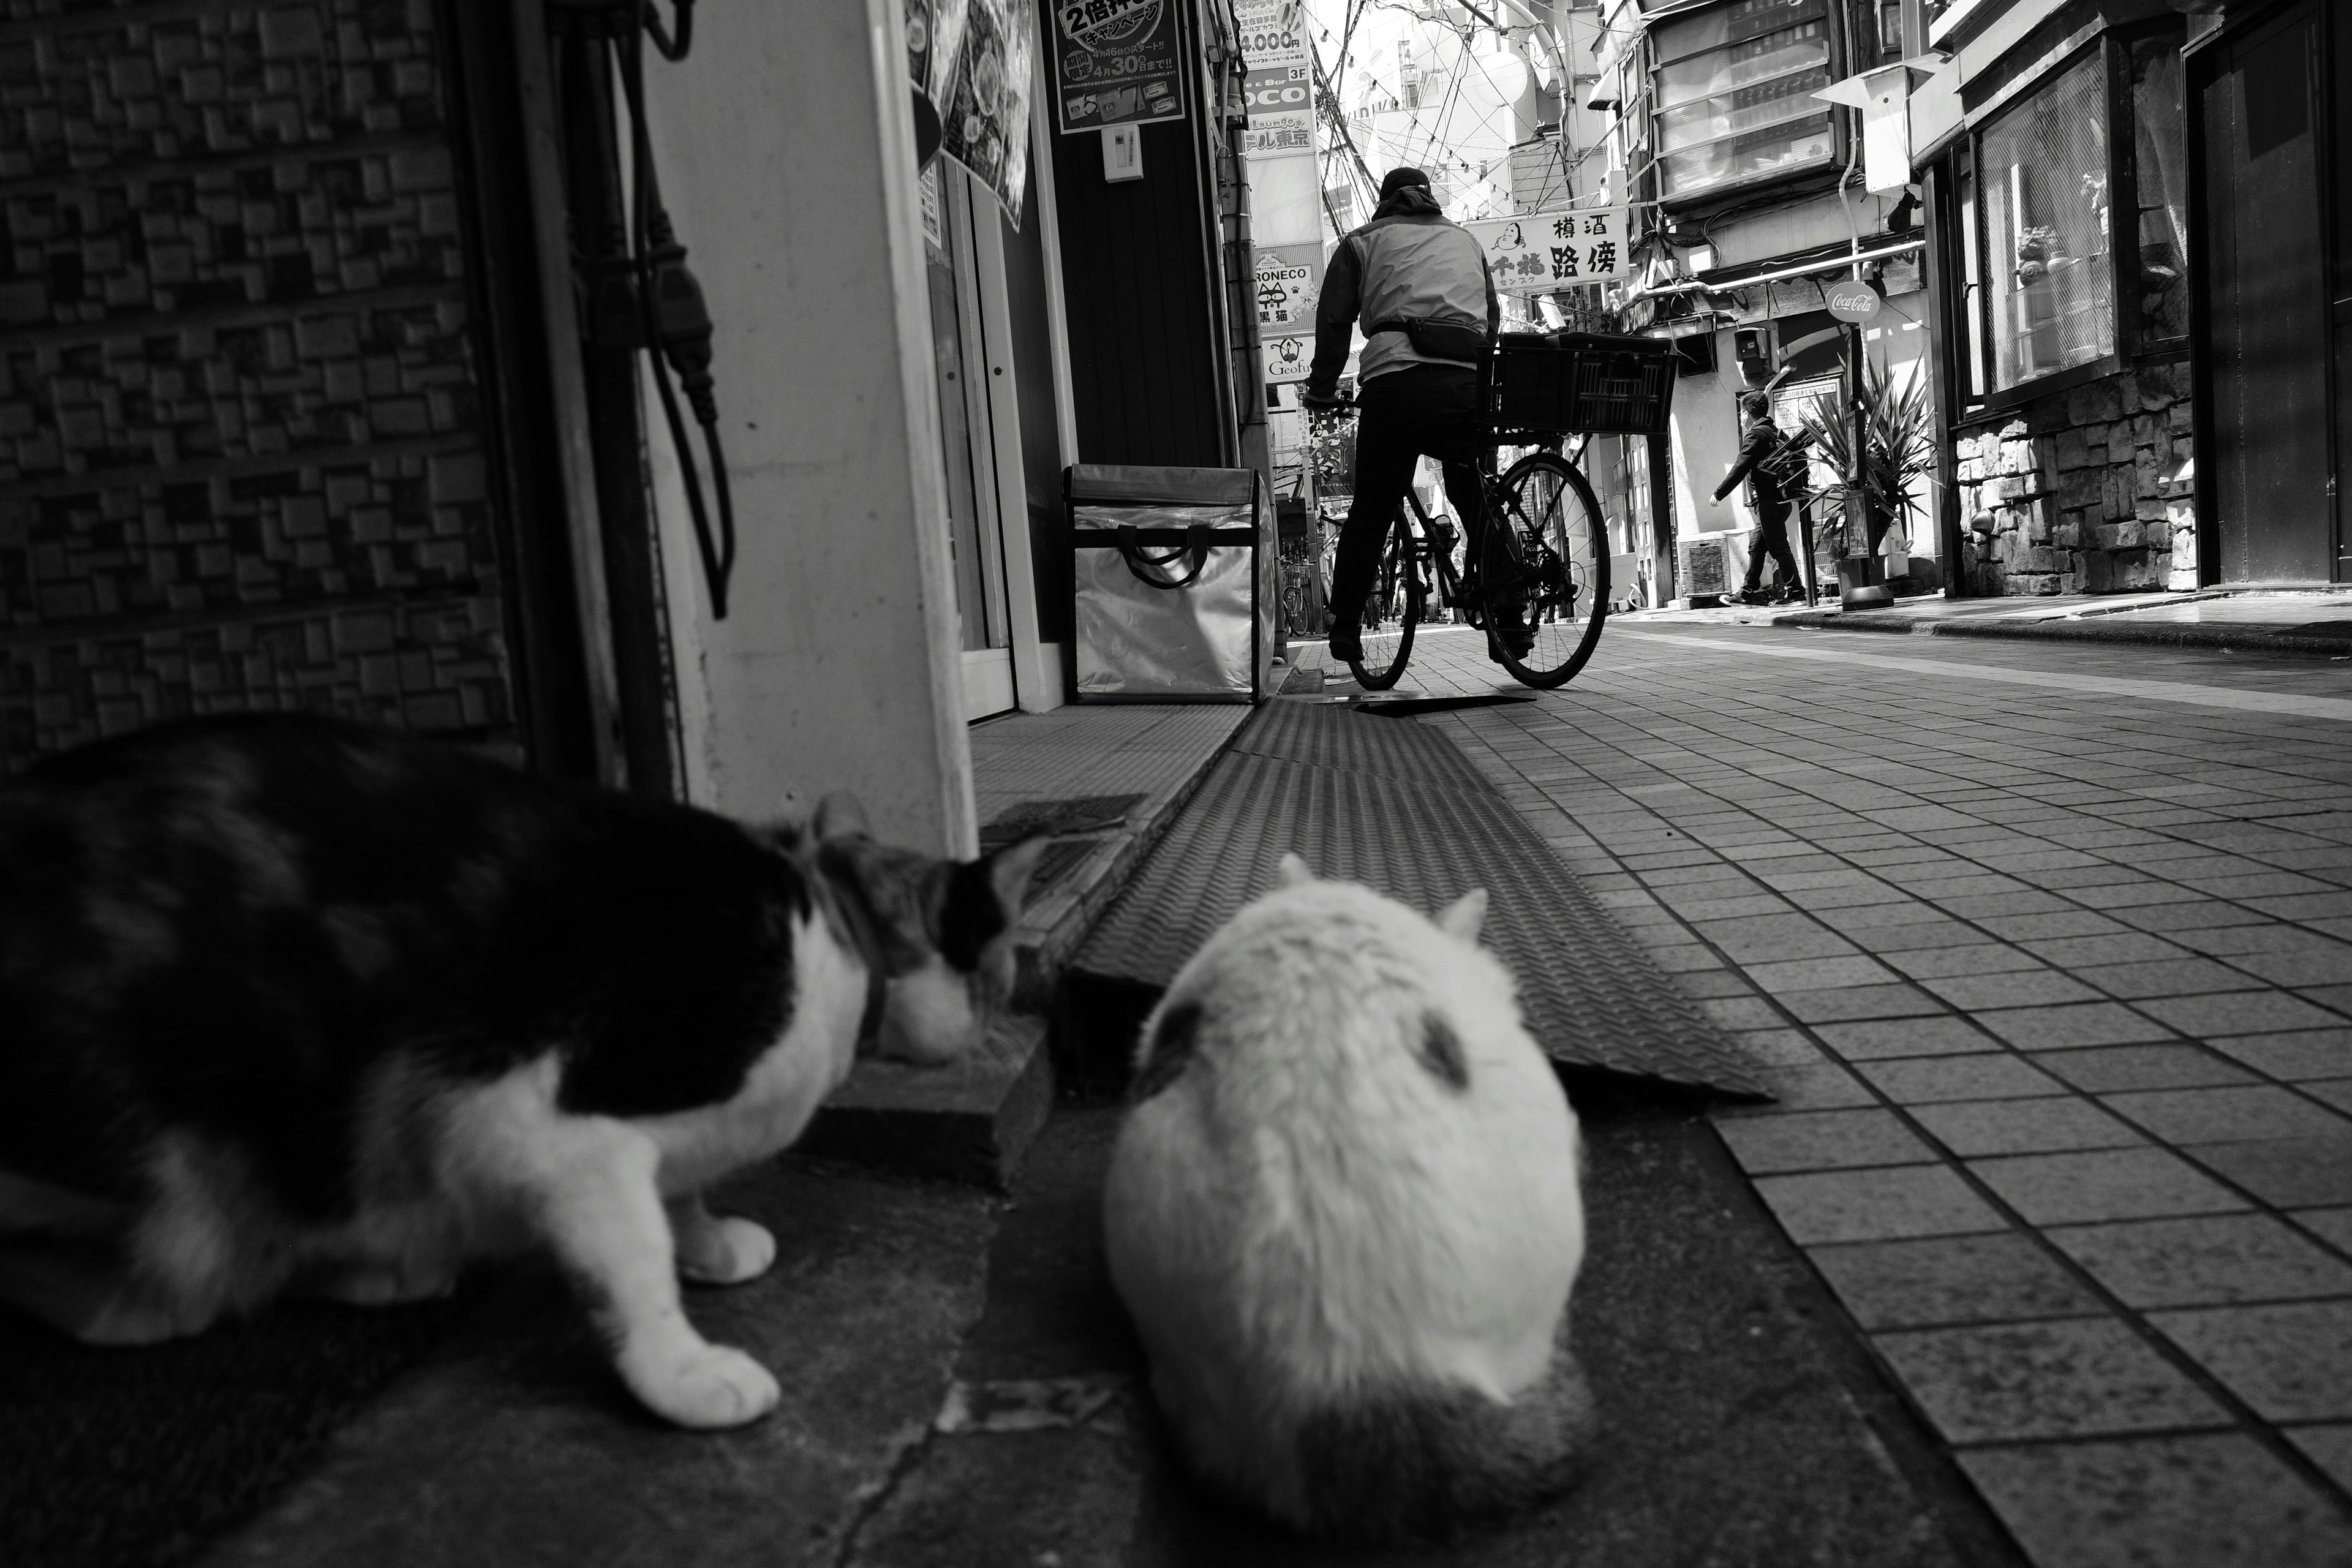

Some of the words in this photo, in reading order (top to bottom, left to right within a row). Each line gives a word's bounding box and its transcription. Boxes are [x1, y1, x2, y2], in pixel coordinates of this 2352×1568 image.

[1086, 6, 1158, 45] キャンペーン
[1240, 15, 1278, 26] 生在籍多数
[1066, 53, 1089, 68] 期間
[1068, 63, 1091, 80] 限定
[1291, 69, 1306, 79] 3F
[1251, 117, 1294, 129] Lounge
